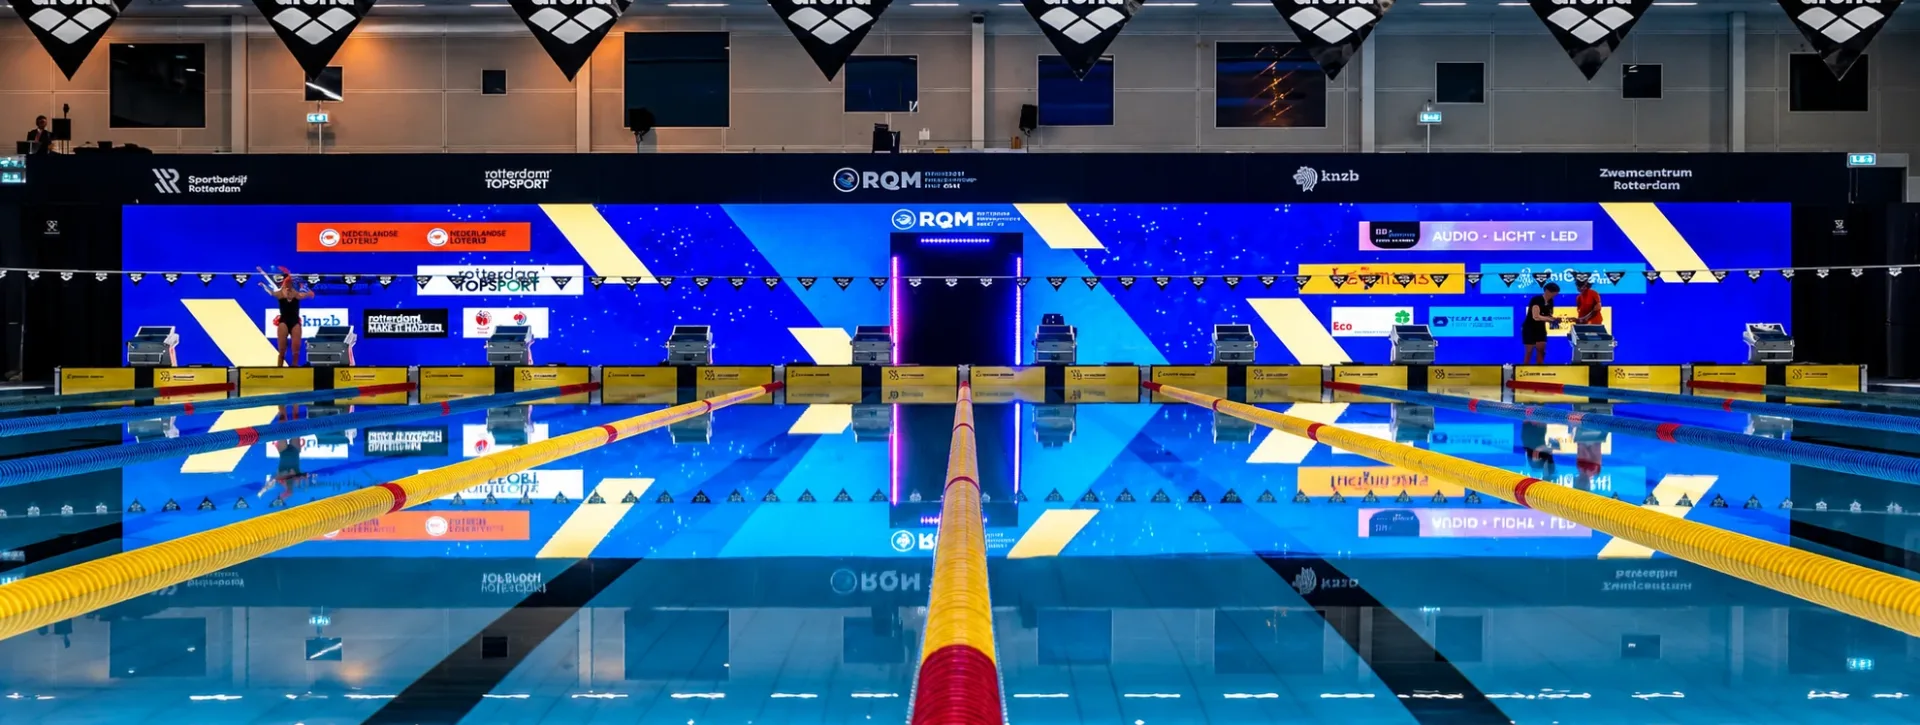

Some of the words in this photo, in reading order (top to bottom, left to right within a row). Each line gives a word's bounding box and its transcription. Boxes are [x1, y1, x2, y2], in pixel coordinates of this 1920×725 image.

[1321, 169, 1360, 182] knzb
[1599, 168, 1693, 178] Zwemcentrum
[188, 175, 248, 186] Sportbedrijf
[485, 179, 549, 189] TOPSPORT
[862, 171, 922, 191] RQM
[1613, 180, 1681, 191] Rotterdam
[188, 184, 242, 193] Rotterdam
[919, 211, 974, 229] RQM
[1432, 230, 1479, 242] AUDIO
[1493, 230, 1536, 242] LICHT
[1550, 230, 1578, 242] LED
[302, 315, 341, 327] knzb
[1333, 321, 1353, 331] Eco
